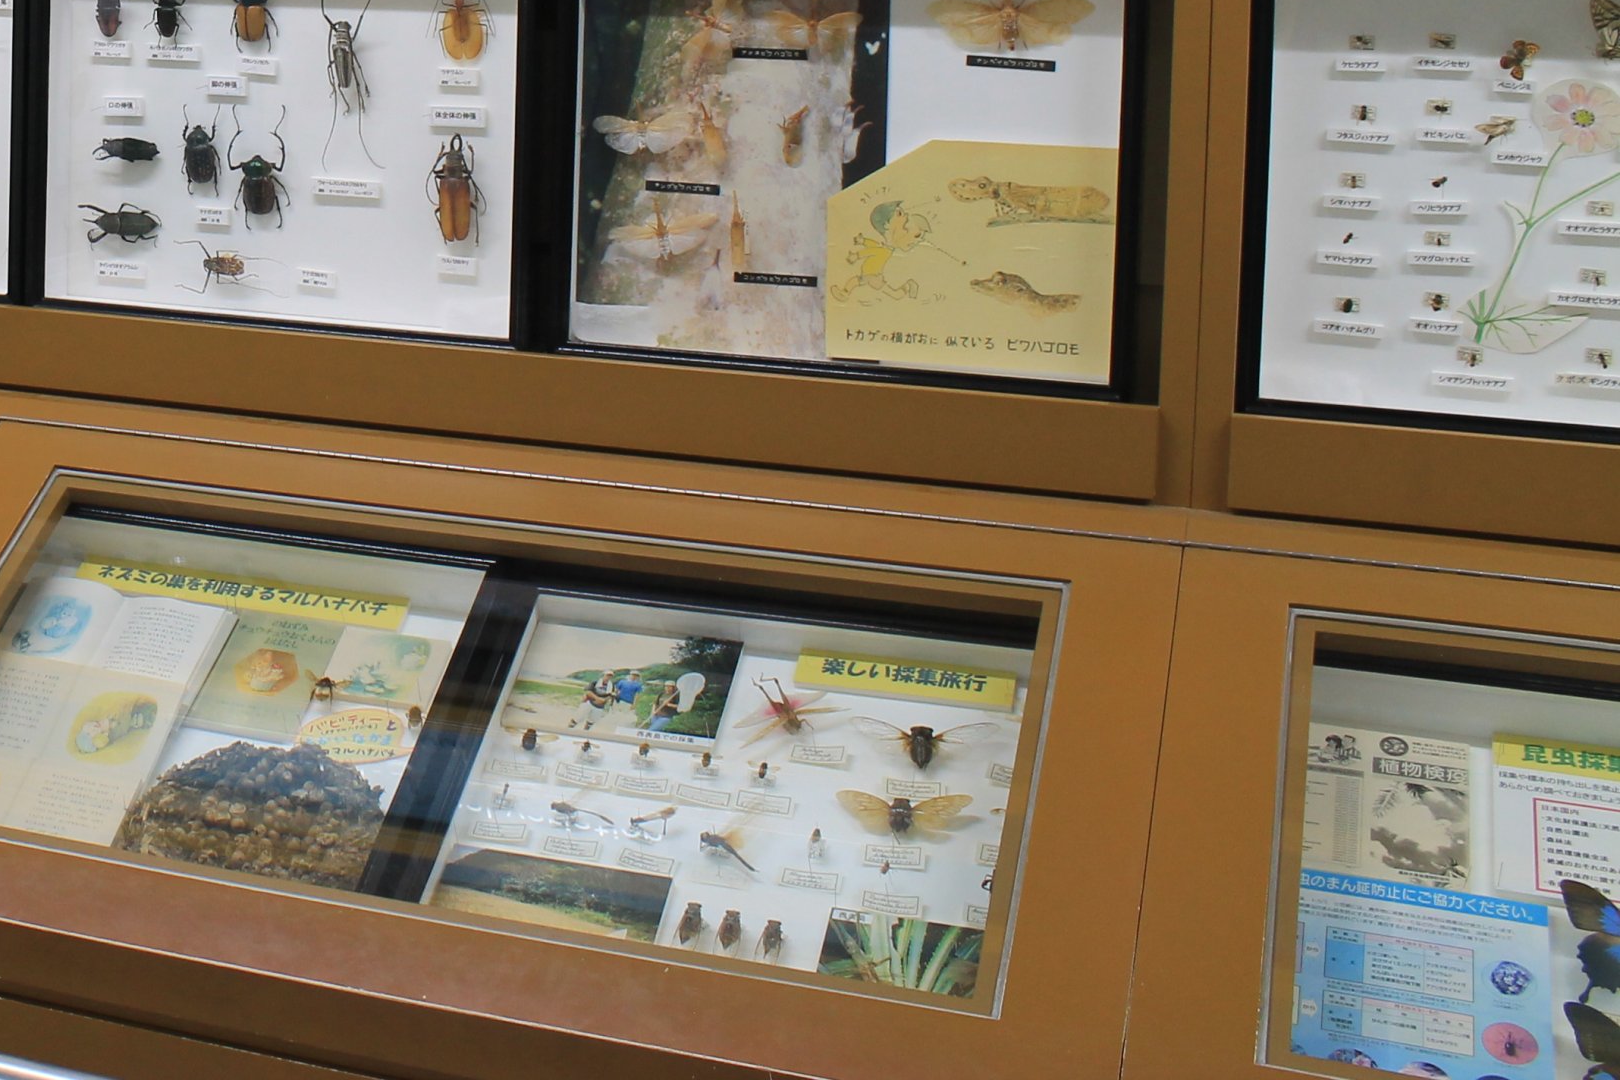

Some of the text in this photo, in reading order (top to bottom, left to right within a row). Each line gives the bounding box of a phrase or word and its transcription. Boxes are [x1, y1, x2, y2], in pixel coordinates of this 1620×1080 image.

[1566, 224, 1620, 234] オオマメヒラタア
[1557, 294, 1620, 306] カオグロオビヒラタ
[1415, 322, 1458, 332] オオハナアブ
[946, 335, 995, 350] 似ている
[1007, 339, 1079, 356] ビワハゴロモ
[98, 565, 388, 616] ネズミの巣を利用するマルハナバチ
[821, 657, 988, 692] 楽しい採集旅行
[1379, 761, 1469, 785] 植物検疫
[1542, 805, 1580, 815] 日本国内
